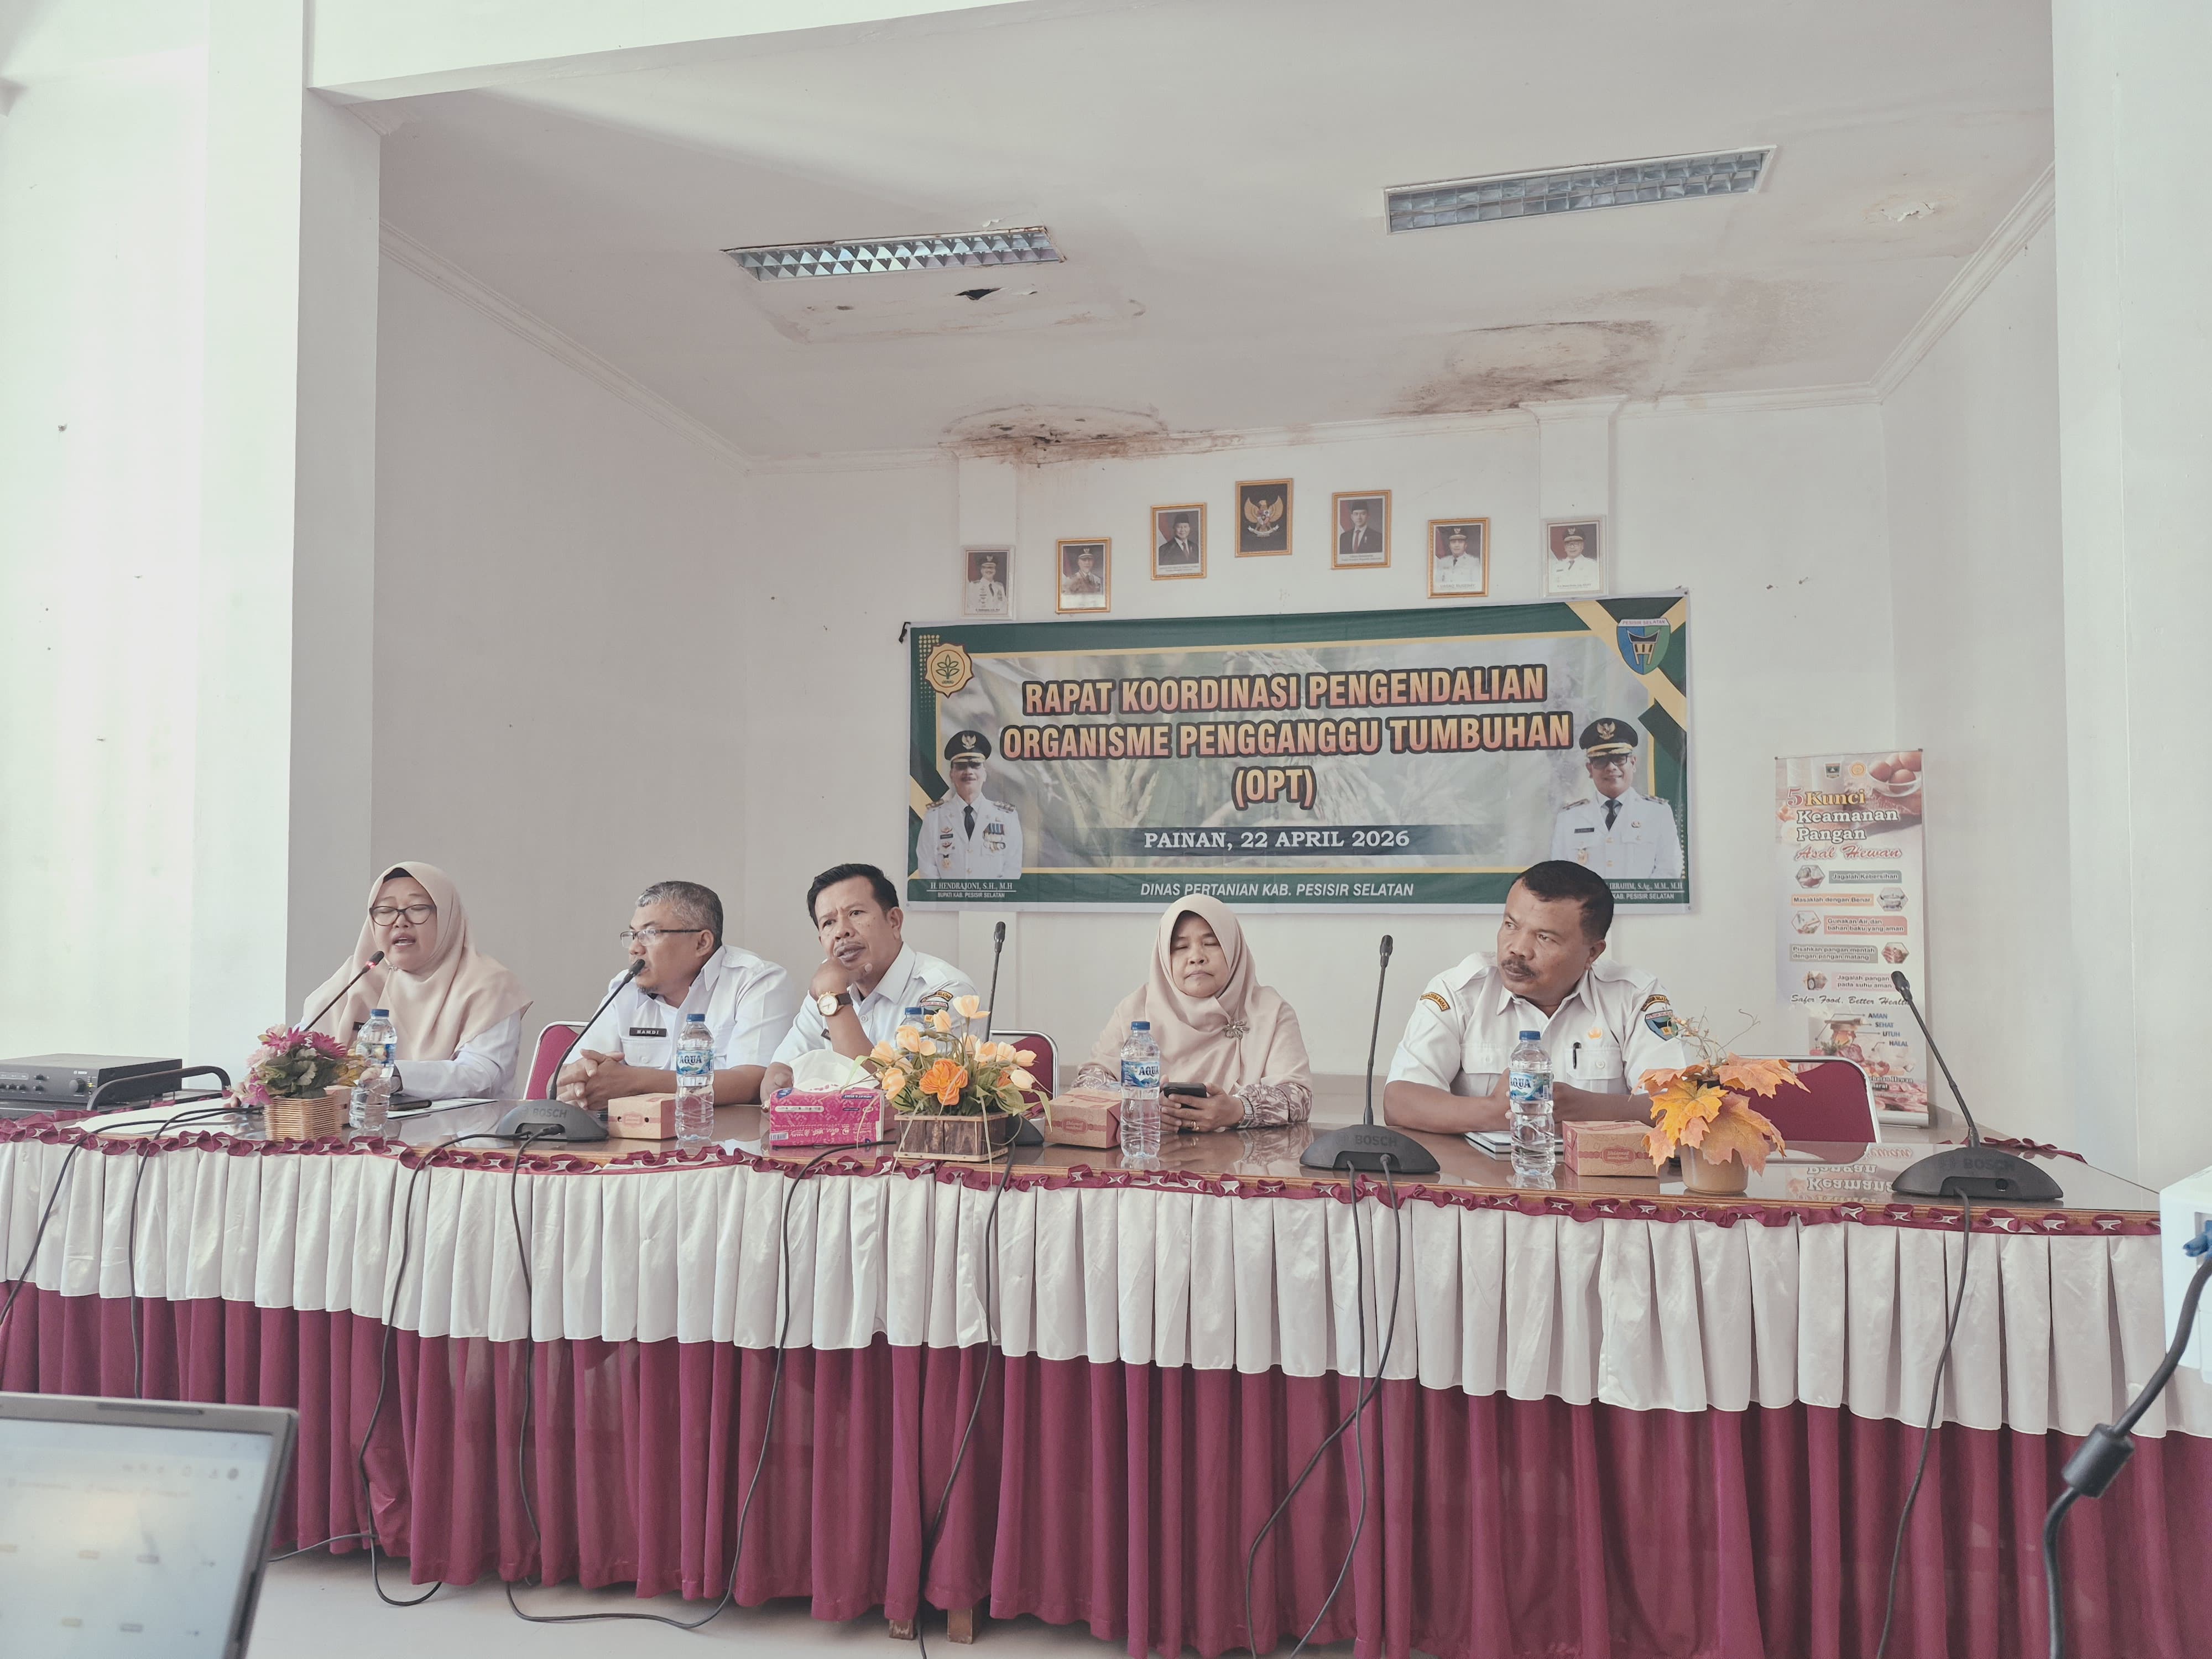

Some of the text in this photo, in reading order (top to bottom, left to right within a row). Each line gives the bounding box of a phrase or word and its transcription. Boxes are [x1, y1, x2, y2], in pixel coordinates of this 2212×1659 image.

[1024, 666, 1545, 714] RAPAT KOORDINASI PENGENDALIAN
[1002, 713, 1571, 759] ORGANISME PENGGANGGU TUMBUHAN
[1234, 768, 1315, 809] (OPT)
[1787, 787, 1865, 807] 5 Kunci
[1797, 810, 1899, 823] Keamanan
[1144, 830, 1410, 851] PAINAN, 22 APRIL 2026
[1797, 827, 1866, 844] Pangan
[1796, 846, 1901, 860] Asal Hewan
[1140, 884, 1413, 896] DINAS PERTANIAN KAB. PESISIR SELATAN
[1791, 994, 1815, 1004] Safer
[1849, 996, 1875, 1005] Better
[680, 1055, 702, 1065] AQUA
[1139, 1066, 1159, 1077] AQUA
[533, 1108, 567, 1118] BOSCH
[1355, 1135, 1397, 1147] BOSCH
[1964, 1158, 2015, 1171] BOSCH
